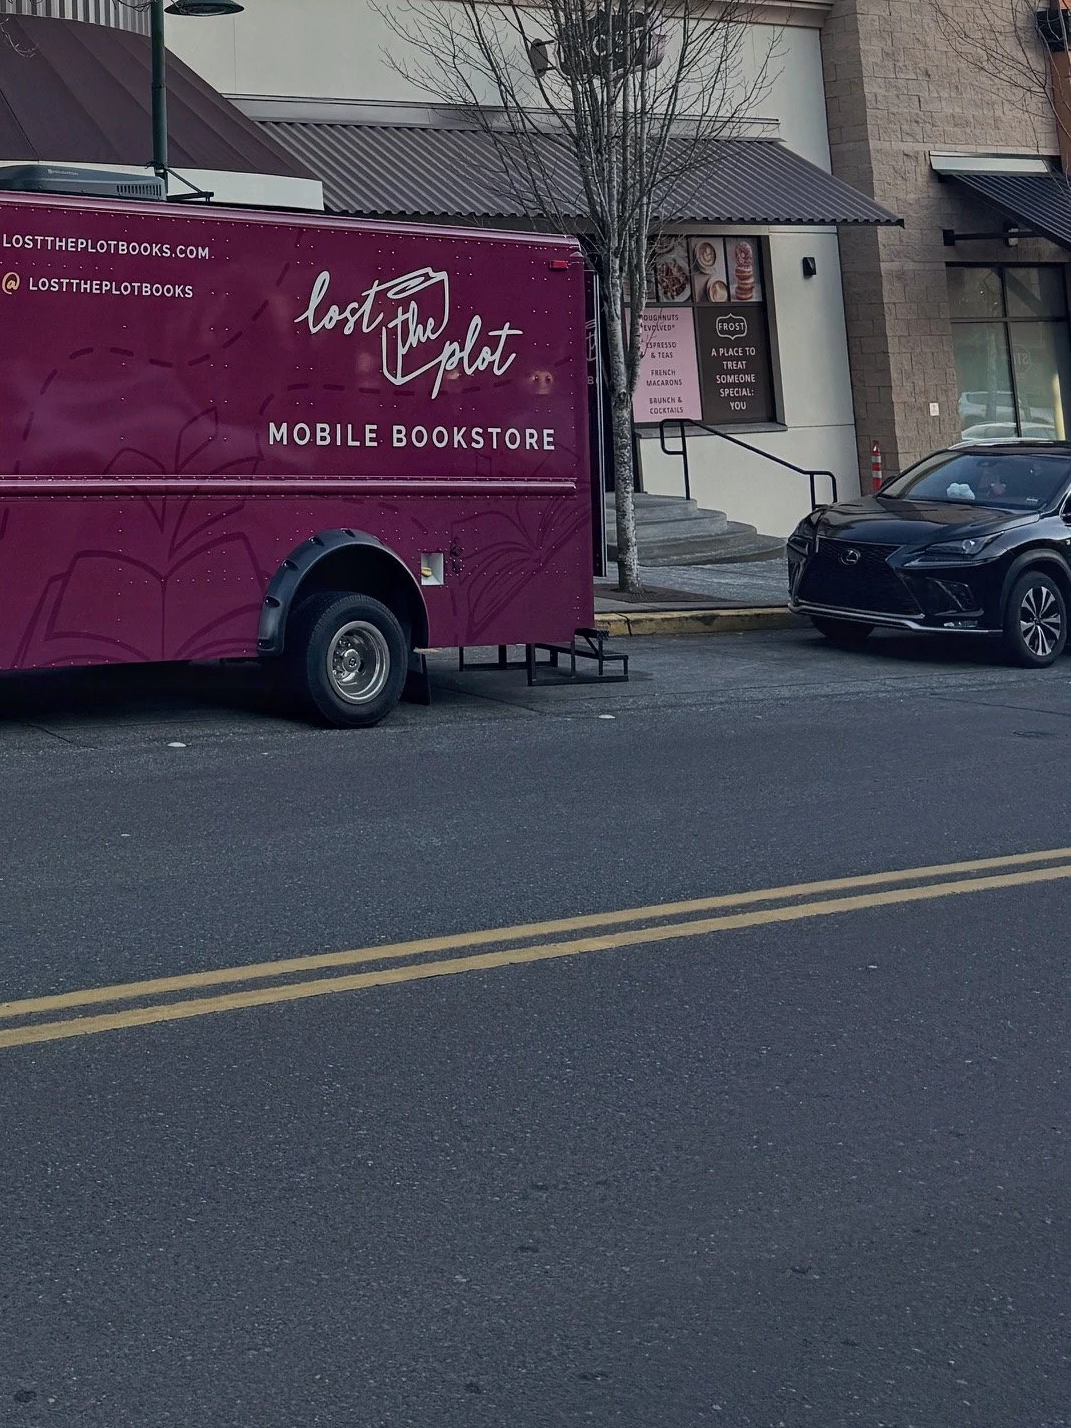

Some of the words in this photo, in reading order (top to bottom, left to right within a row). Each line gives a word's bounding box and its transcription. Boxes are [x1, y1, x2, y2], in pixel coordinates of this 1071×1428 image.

[3, 234, 209, 259] LOSTTHEPLOTBOOKS.COM
[29, 277, 193, 298] LOSTTHEPLOTBOOKS
[718, 322, 745, 331] FROST
[294, 271, 383, 334] lost
[388, 300, 443, 355] the
[431, 315, 523, 399] plot
[646, 341, 677, 349] ESPRESSO
[711, 348, 717, 356] A
[719, 347, 743, 356] PLACE
[745, 347, 756, 356] TO
[723, 361, 746, 370] TREAT
[716, 374, 756, 383] SOMEONE
[719, 388, 754, 397] SPECIAL:
[730, 401, 747, 410] YOU
[268, 422, 378, 447] MOBILE
[392, 425, 555, 450] BOOKSTORE
